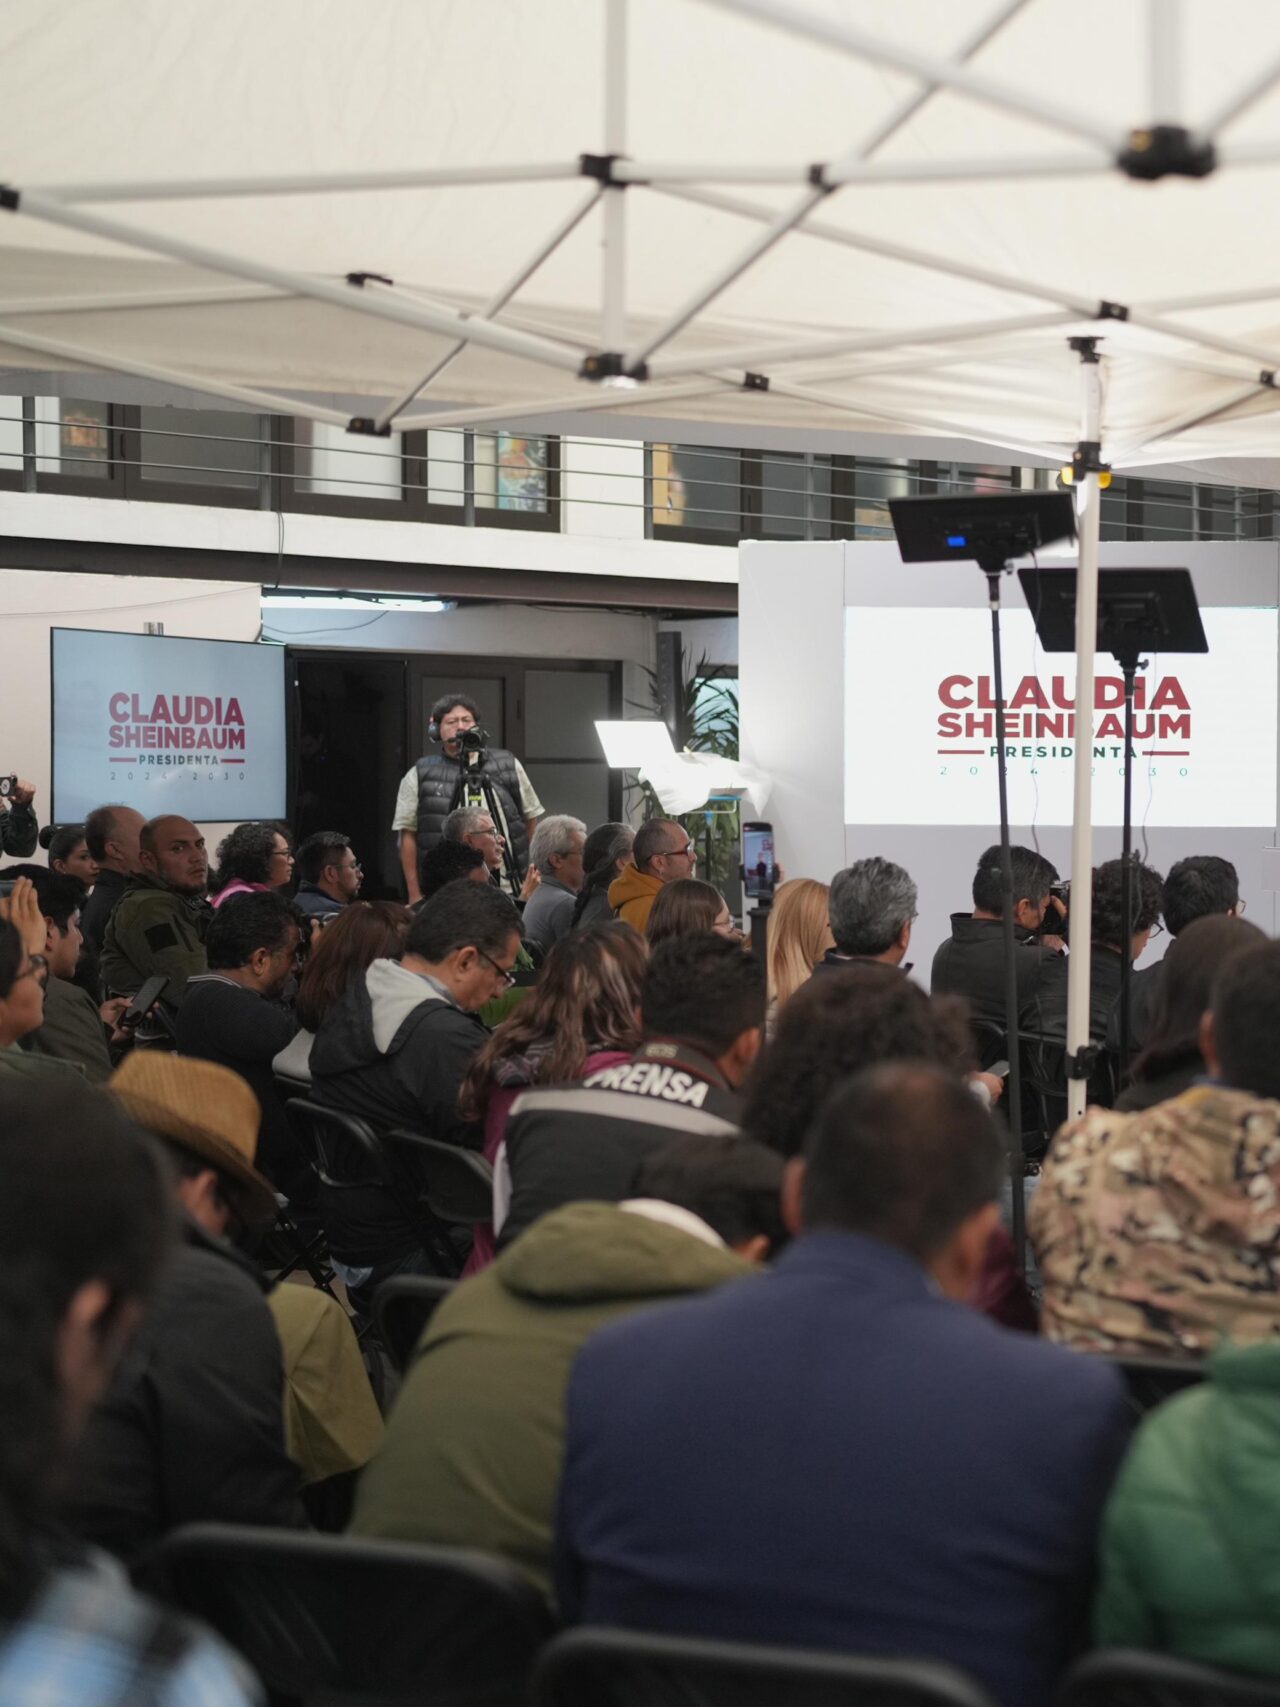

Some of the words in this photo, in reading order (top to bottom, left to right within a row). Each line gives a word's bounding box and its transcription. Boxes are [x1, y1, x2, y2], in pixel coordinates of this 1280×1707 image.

[937, 675, 1192, 710] CLAUDIA
[109, 692, 246, 726] CLAUDIA
[108, 725, 246, 750] SHEINBAUM
[937, 712, 1192, 739] SHEINAUM
[138, 754, 219, 766] PRESIDENTA
[990, 746, 1138, 758] PRESIDNTA
